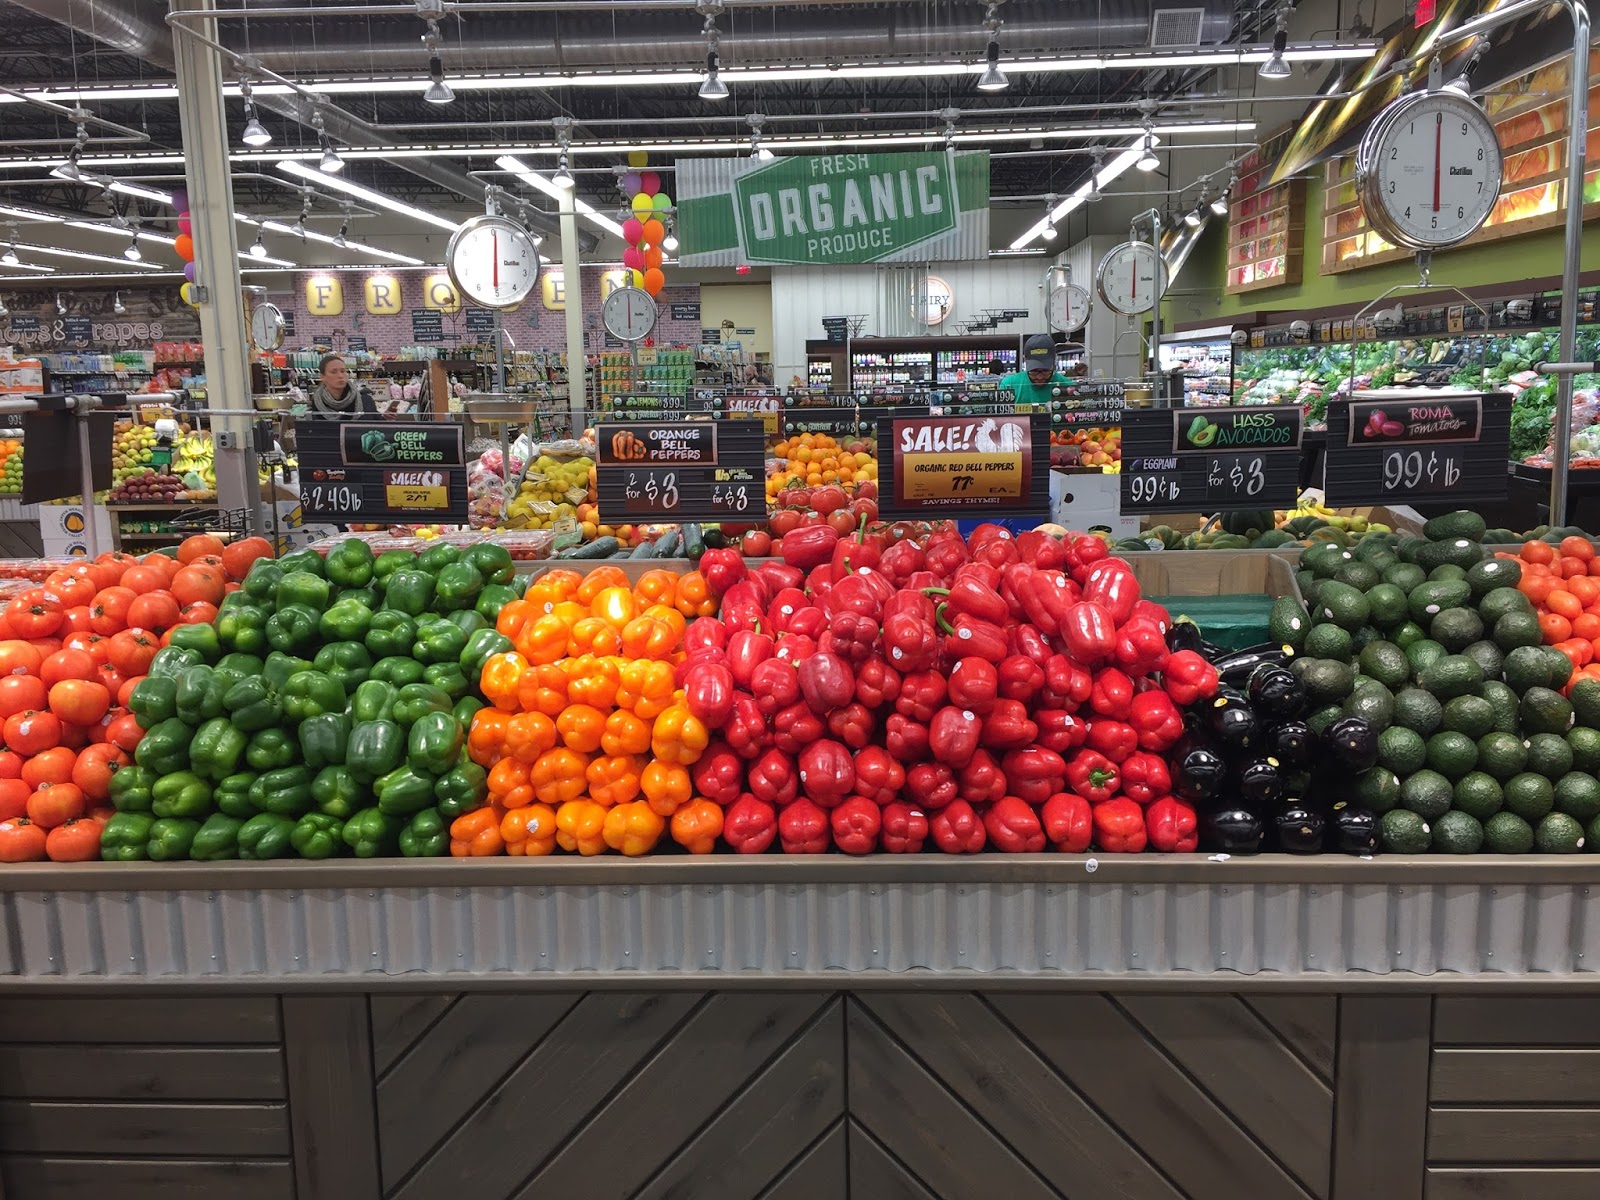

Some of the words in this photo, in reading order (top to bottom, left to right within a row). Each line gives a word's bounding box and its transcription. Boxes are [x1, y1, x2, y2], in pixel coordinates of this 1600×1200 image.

[1436, 112, 1442, 125] 0
[1410, 122, 1414, 135] 1
[1461, 123, 1468, 136] 9
[1391, 148, 1398, 160] 2
[1477, 149, 1484, 161] 8
[810, 154, 870, 177] FRESH
[1389, 181, 1396, 194] 3
[1477, 182, 1483, 194] 7
[750, 165, 944, 241] ORGANIC
[1404, 206, 1411, 219] 4
[1458, 206, 1464, 219] 6
[1431, 216, 1437, 229] 5
[807, 227, 893, 258] PRODUCE
[911, 295, 950, 306] AIRY
[0, 325, 51, 348] ops
[53, 319, 66, 340] &
[75, 322, 164, 347] rapes
[1408, 405, 1454, 420] ROMA
[1233, 413, 1276, 429] HASS
[1407, 418, 1467, 436] Tomatoes
[394, 431, 427, 442] GREEN
[649, 429, 700, 440] ORANGE
[901, 424, 976, 453] SALE!
[1216, 426, 1291, 445] AVOCADOS
[401, 441, 425, 450] BELL
[661, 440, 691, 450] BELL
[397, 451, 443, 461] PEPPERS
[651, 450, 701, 460] PEPPERS
[914, 463, 947, 473] ORGANIC
[949, 463, 964, 472] RED
[965, 463, 983, 472] BELL
[985, 462, 1015, 471] PEPPERS
[1143, 458, 1178, 470] EGGPLANT
[1212, 459, 1221, 472] 2
[391, 472, 422, 485] SALE!
[629, 472, 637, 486] 2
[1444, 458, 1461, 487] lb
[952, 475, 974, 491] 77¢
[1208, 474, 1224, 487] for
[626, 486, 641, 499] for
[1169, 481, 1181, 501] lb
[712, 494, 723, 503] for
[922, 497, 961, 505] SAVINGS
